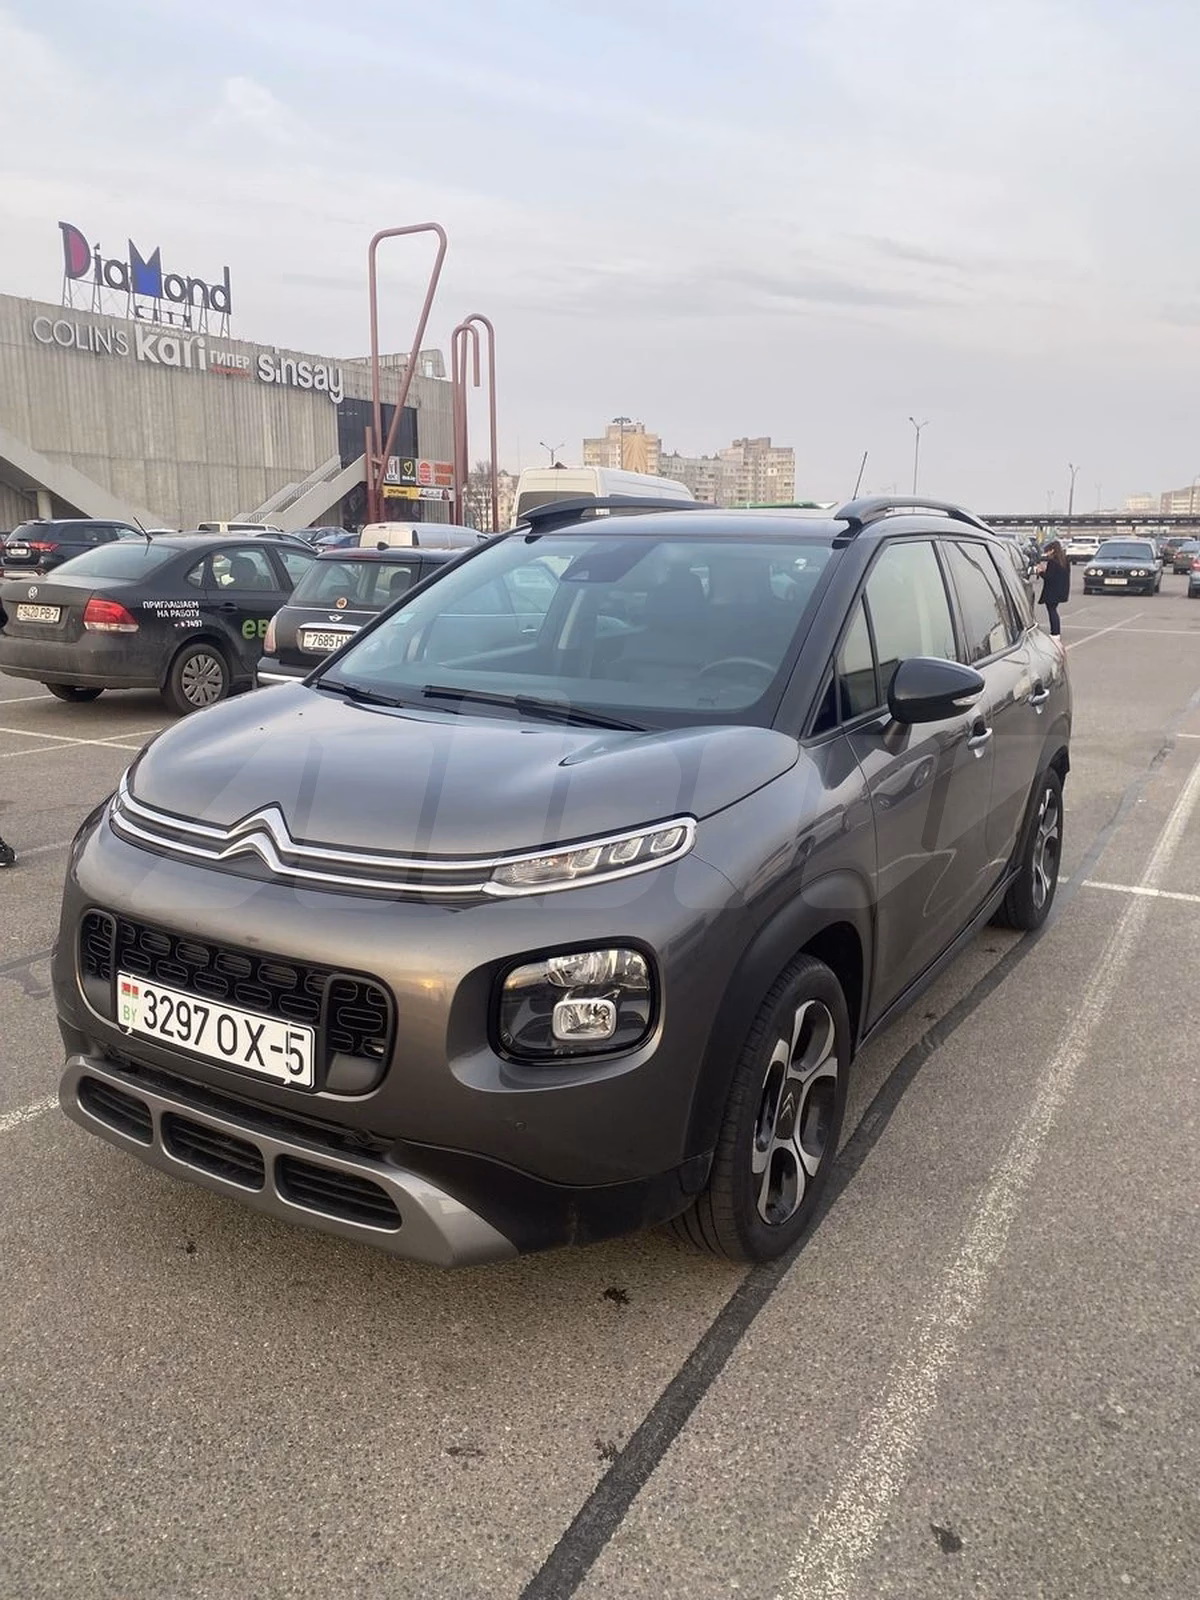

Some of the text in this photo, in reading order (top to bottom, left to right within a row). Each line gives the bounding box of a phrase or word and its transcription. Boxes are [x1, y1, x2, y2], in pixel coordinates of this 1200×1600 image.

[59, 221, 231, 314] DiaMond
[135, 305, 192, 328] CITY
[32, 316, 129, 356] COLIN'S
[135, 324, 207, 370] kari
[209, 350, 250, 369] ГИПЕР
[257, 347, 344, 404] sinsay
[156, 609, 199, 618] НА РАБОТУ
[312, 634, 335, 647] 7685
[123, 1003, 137, 1021] BY
[143, 990, 209, 1046] 3297
